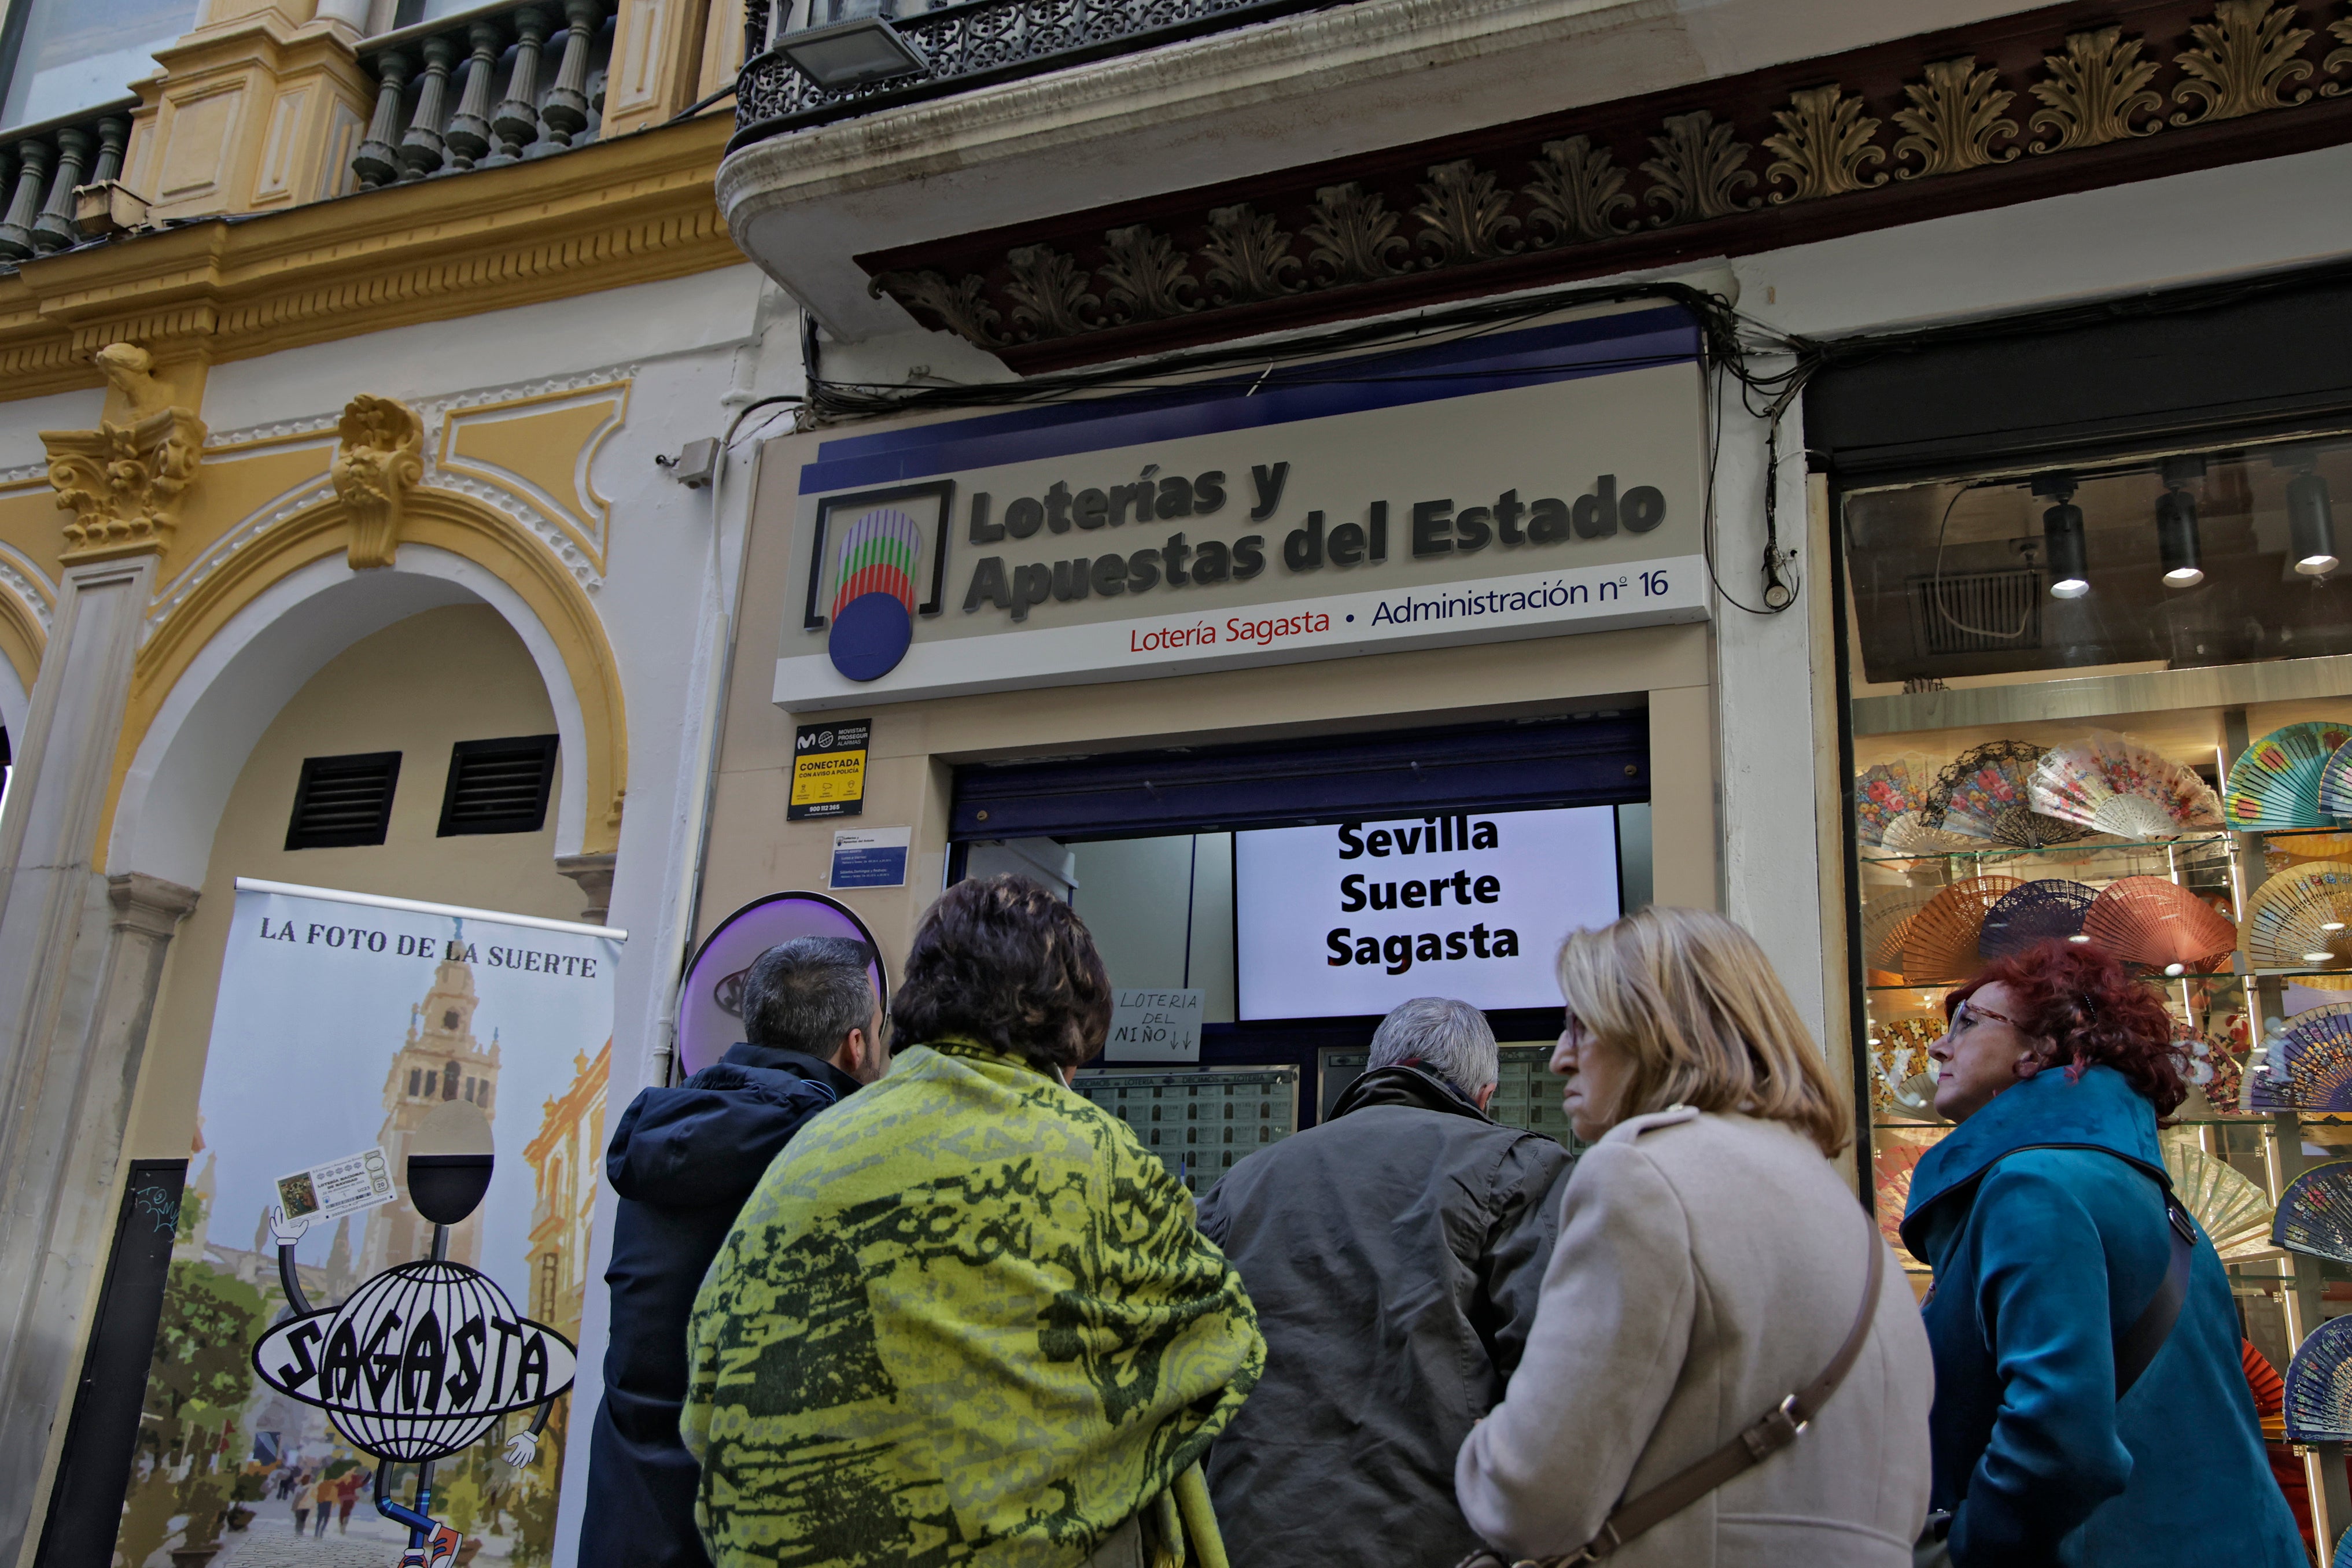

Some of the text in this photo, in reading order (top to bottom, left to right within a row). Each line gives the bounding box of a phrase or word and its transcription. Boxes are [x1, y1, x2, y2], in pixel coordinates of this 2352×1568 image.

[969, 461, 1291, 545] Loterías y
[963, 474, 1667, 623] Apuestas del Estado
[1130, 620, 1216, 652] Lotería
[1226, 611, 1329, 645] Sagasta
[1371, 580, 1588, 626] Administración
[1638, 570, 1669, 597] 16
[836, 739, 862, 747] ALARMAS
[837, 732, 868, 741] PROSEGUR
[838, 727, 867, 735] MOVISTAR
[799, 758, 860, 772] CONECTADA
[836, 766, 860, 775] POLICÍA
[1337, 815, 1499, 860] Sevilla
[1340, 869, 1501, 913] Suerte
[260, 917, 598, 979] LA FOTO DE LA SUERTE
[1326, 922, 1519, 976] Sagasta
[1120, 992, 1197, 1009] LOTERIA
[1115, 1025, 1167, 1043] NIÑO
[1142, 1013, 1176, 1025] DEL
[278, 1308, 548, 1412] SAGASTA
